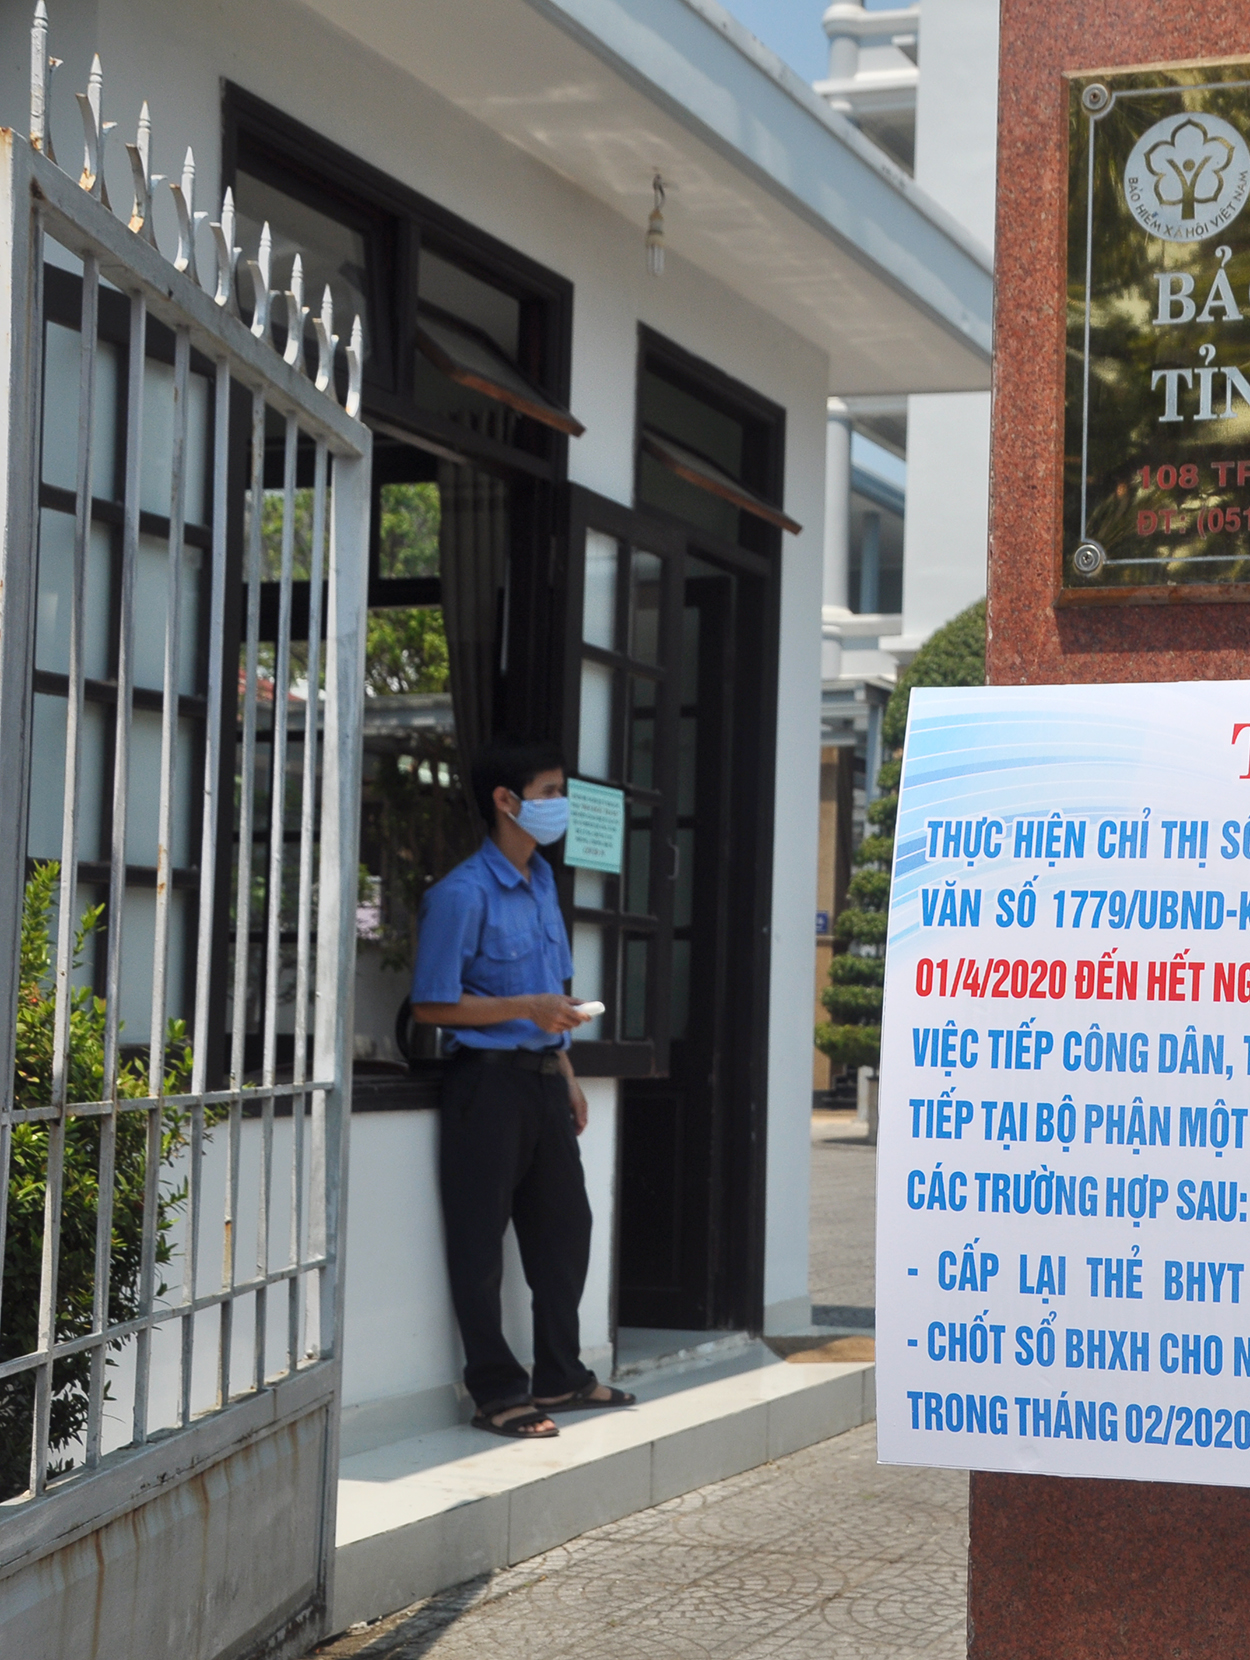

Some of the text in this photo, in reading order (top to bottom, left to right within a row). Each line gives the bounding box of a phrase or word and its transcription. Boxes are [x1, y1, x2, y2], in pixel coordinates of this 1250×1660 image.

[1233, 169, 1249, 202] NAM
[1136, 463, 1199, 491] 108
[1136, 508, 1187, 537] ĐT:
[927, 816, 1003, 867] THỰC
[1013, 812, 1087, 868] HIỆN
[1097, 807, 1151, 859] CHỈ
[1161, 820, 1209, 868] THỊ
[921, 880, 982, 927] VĂN
[995, 875, 1039, 928] SỐ
[915, 957, 1067, 1000] 01/4/2020
[1074, 947, 1139, 1001] ĐẾN
[1147, 948, 1206, 1002] HẾT
[912, 1019, 979, 1077] VIỆC
[988, 1017, 1054, 1070] TIẾP
[1062, 1023, 1149, 1073] CÔNG
[1158, 1025, 1233, 1081] DÂN,
[909, 1086, 974, 1140] TIẾP
[981, 1100, 1028, 1151] TẠI
[1035, 1094, 1077, 1153] BỘ
[1084, 1096, 1171, 1155] PHẬN
[1179, 1098, 1249, 1158] MỘT
[907, 1161, 1248, 1228] CÁC TRƯỜNG HỢP SAU:
[907, 1268, 919, 1276] -
[938, 1237, 999, 1292] CẤP
[1019, 1254, 1066, 1304] LẠI
[1086, 1244, 1143, 1299] THẺ
[1164, 1260, 1245, 1304] BHYT
[907, 1338, 918, 1347] -
[927, 1309, 1006, 1364] CHỐT
[1014, 1310, 1057, 1367] SỔ
[1065, 1328, 1150, 1372] BHXH
[1160, 1332, 1223, 1376] CHO
[906, 1390, 1008, 1435] TRONG
[1014, 1390, 1118, 1442] THÁNG
